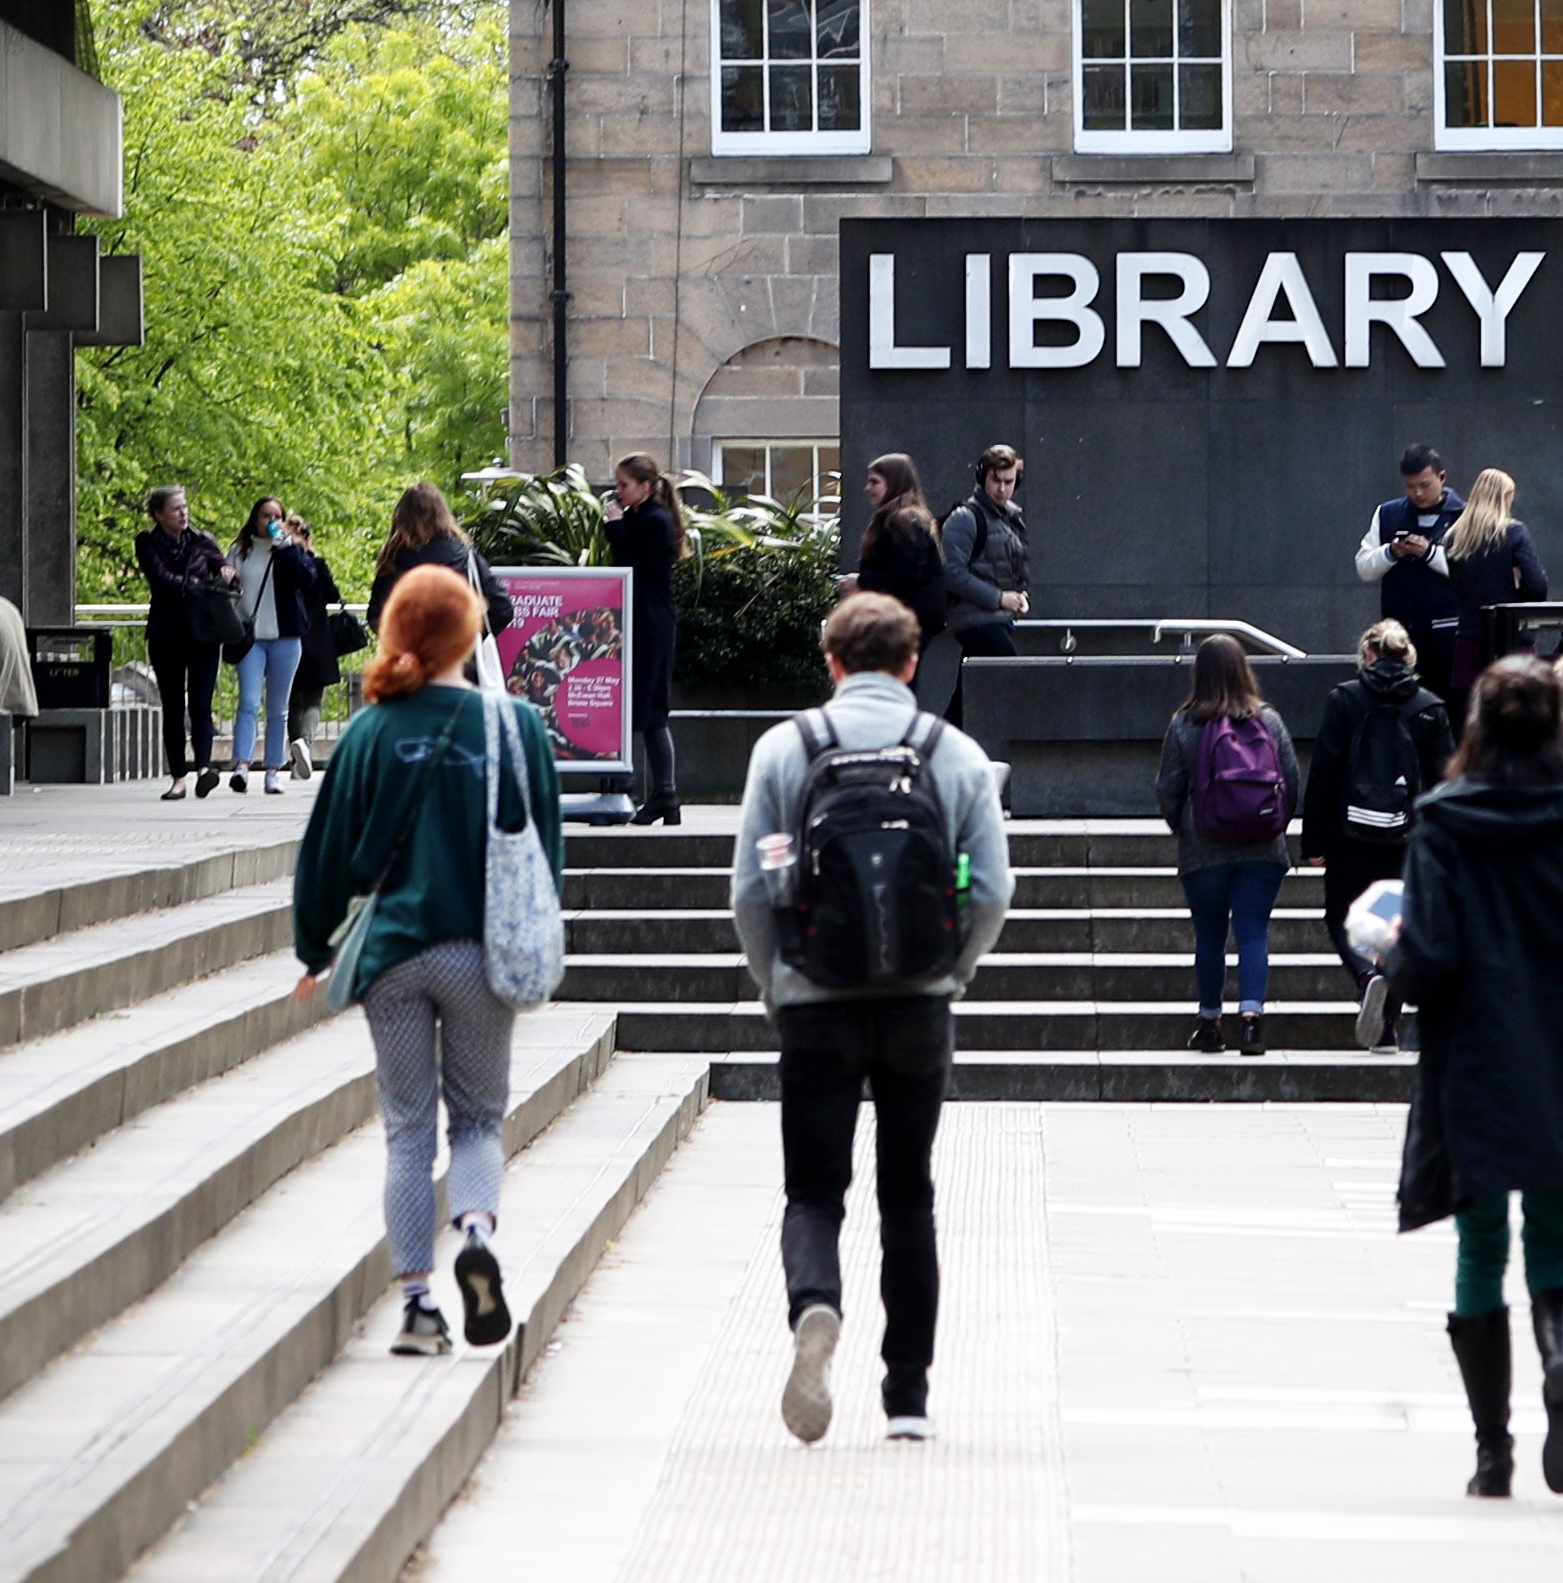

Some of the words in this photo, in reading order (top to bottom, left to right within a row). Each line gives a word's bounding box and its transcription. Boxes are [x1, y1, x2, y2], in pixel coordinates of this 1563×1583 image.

[868, 250, 1547, 369] LIBRARY
[510, 595, 564, 607] RADUATE
[533, 606, 559, 618] FAIR
